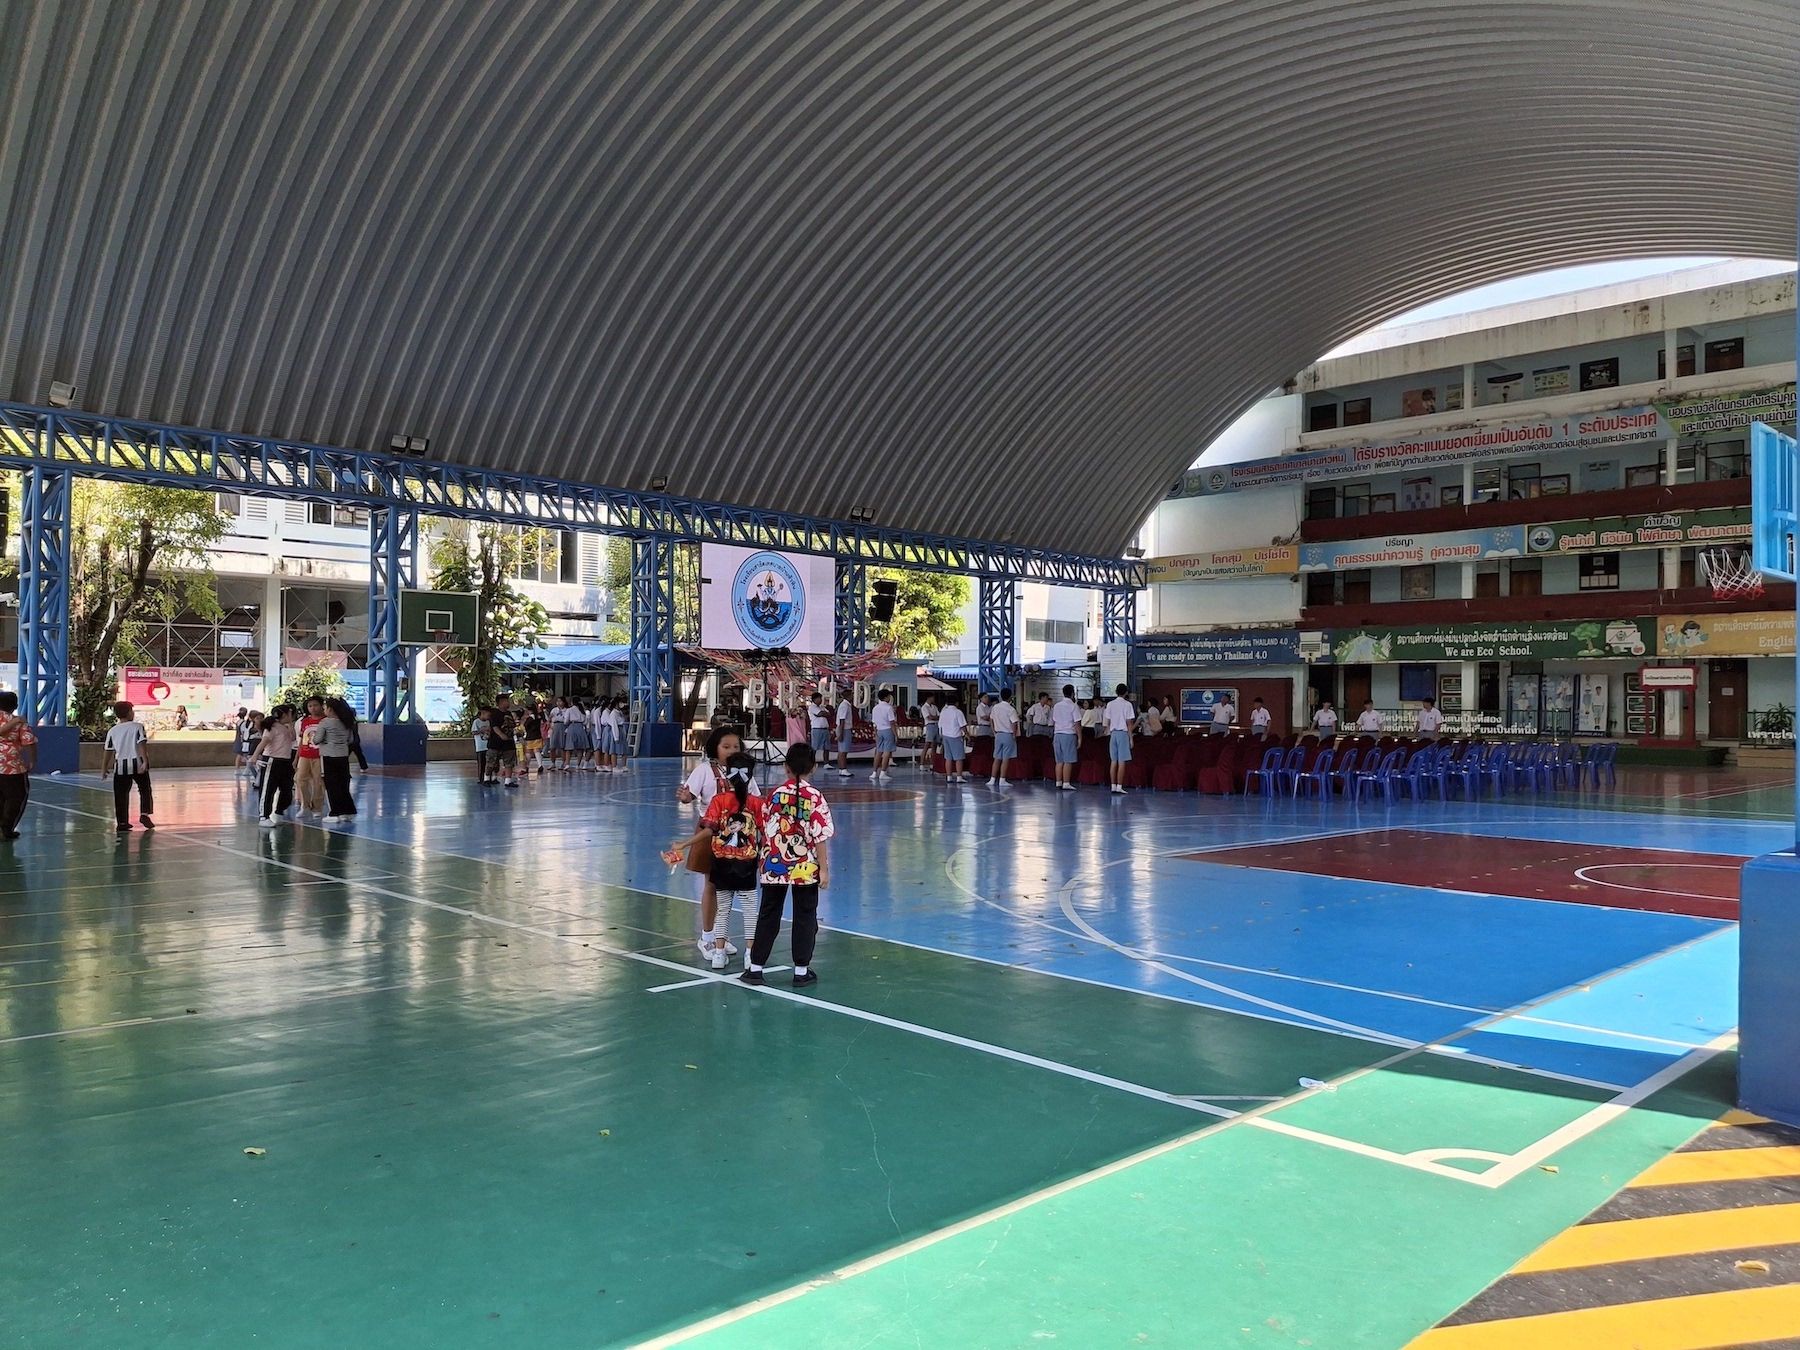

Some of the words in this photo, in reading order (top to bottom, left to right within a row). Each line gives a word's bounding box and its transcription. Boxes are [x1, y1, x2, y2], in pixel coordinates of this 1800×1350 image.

[1562, 422, 1569, 436] 1
[1579, 411, 1657, 434] ระดับประเทศ
[1644, 515, 1681, 528] คำขวัญ
[1385, 537, 1414, 547] ปรัชญา
[1559, 531, 1596, 550] รู้หน้าที่
[1601, 531, 1633, 546] มีวินัย
[1637, 528, 1682, 543] ใฝ่ศึกษา
[1334, 547, 1424, 568] คุณธรรมนำความรู้
[1430, 544, 1480, 562] คู่ความสุข
[1713, 615, 1797, 632] สถานศึกษาที่มีความพร้
[1253, 638, 1278, 646] THAILAND
[1279, 637, 1289, 646] 4.0
[1146, 652, 1156, 661] We
[1157, 653, 1167, 661] are
[1168, 652, 1186, 662] ready
[1187, 652, 1195, 660] to
[1215, 652, 1223, 660] to
[1224, 651, 1253, 660] Thailand
[1255, 651, 1268, 660] 4.0
[1445, 647, 1458, 657] We
[1461, 648, 1474, 656] are
[1477, 647, 1493, 656] Eco
[1499, 645, 1532, 656] School.
[1747, 729, 1797, 740] เพราะโร
